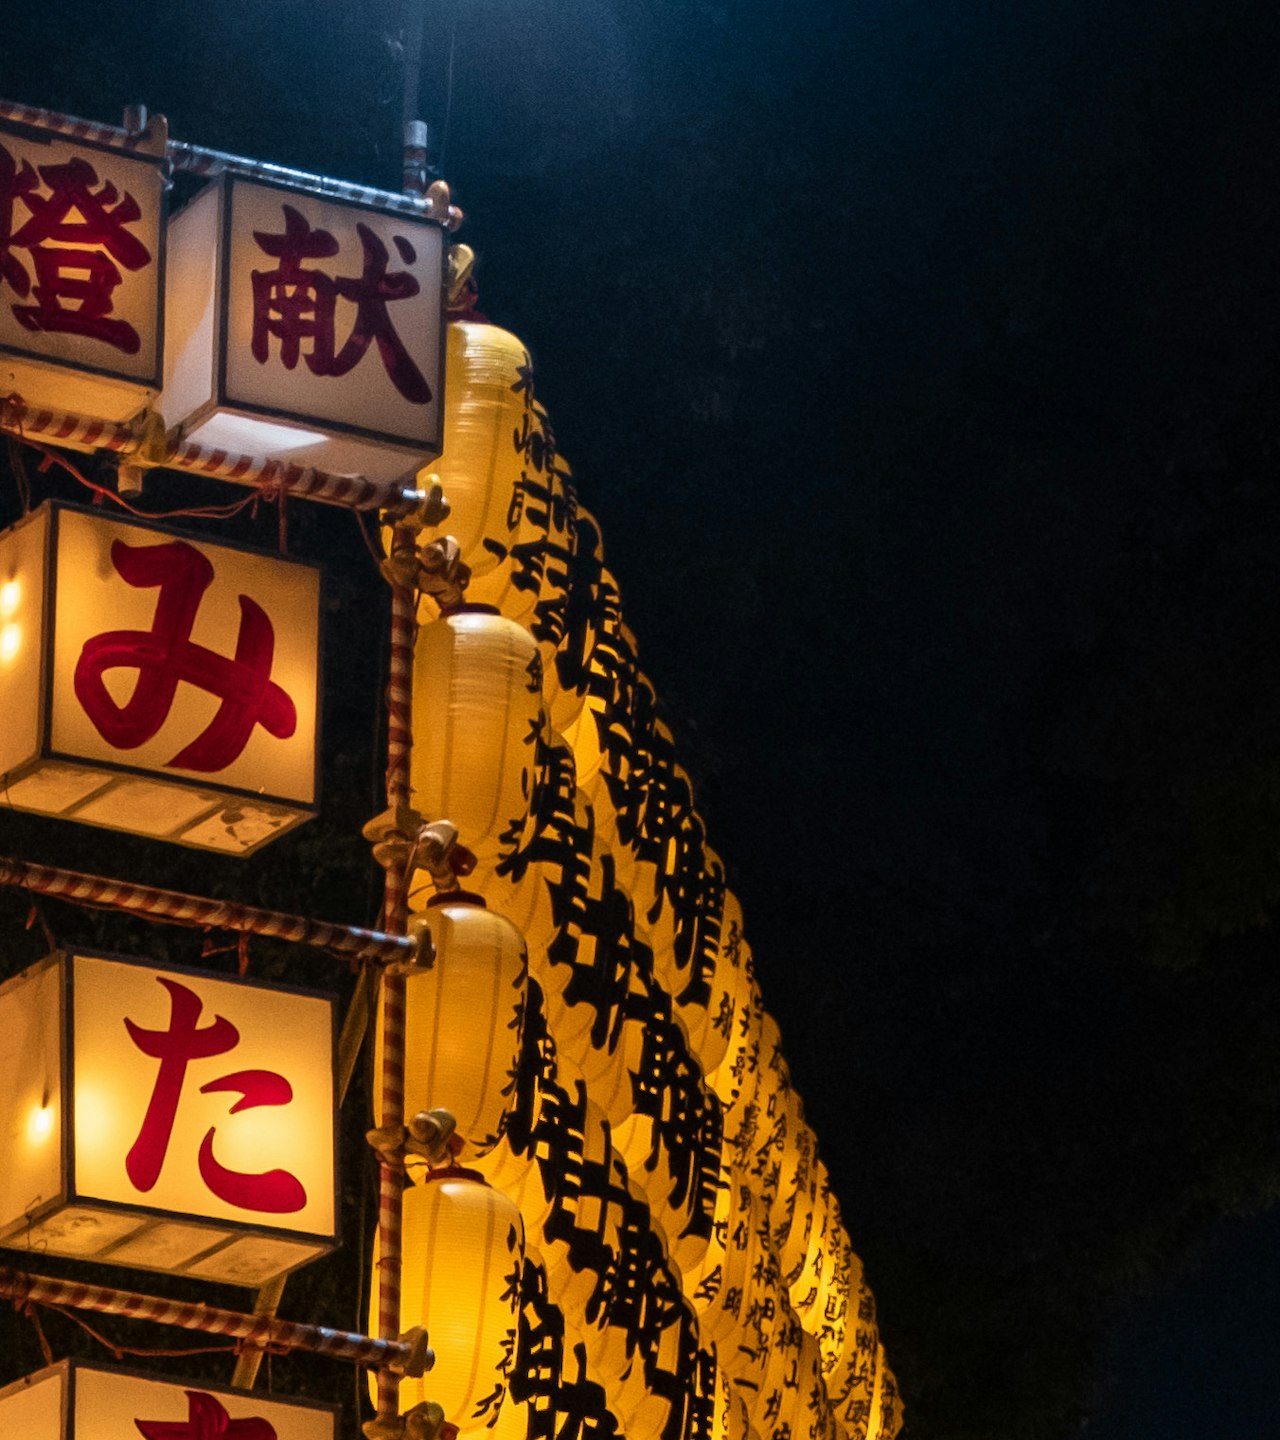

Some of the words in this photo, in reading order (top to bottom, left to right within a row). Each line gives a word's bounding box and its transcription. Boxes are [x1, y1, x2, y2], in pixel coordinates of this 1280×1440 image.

[251, 204, 432, 404] 献
[75, 539, 296, 771] み
[124, 976, 307, 1213] た
